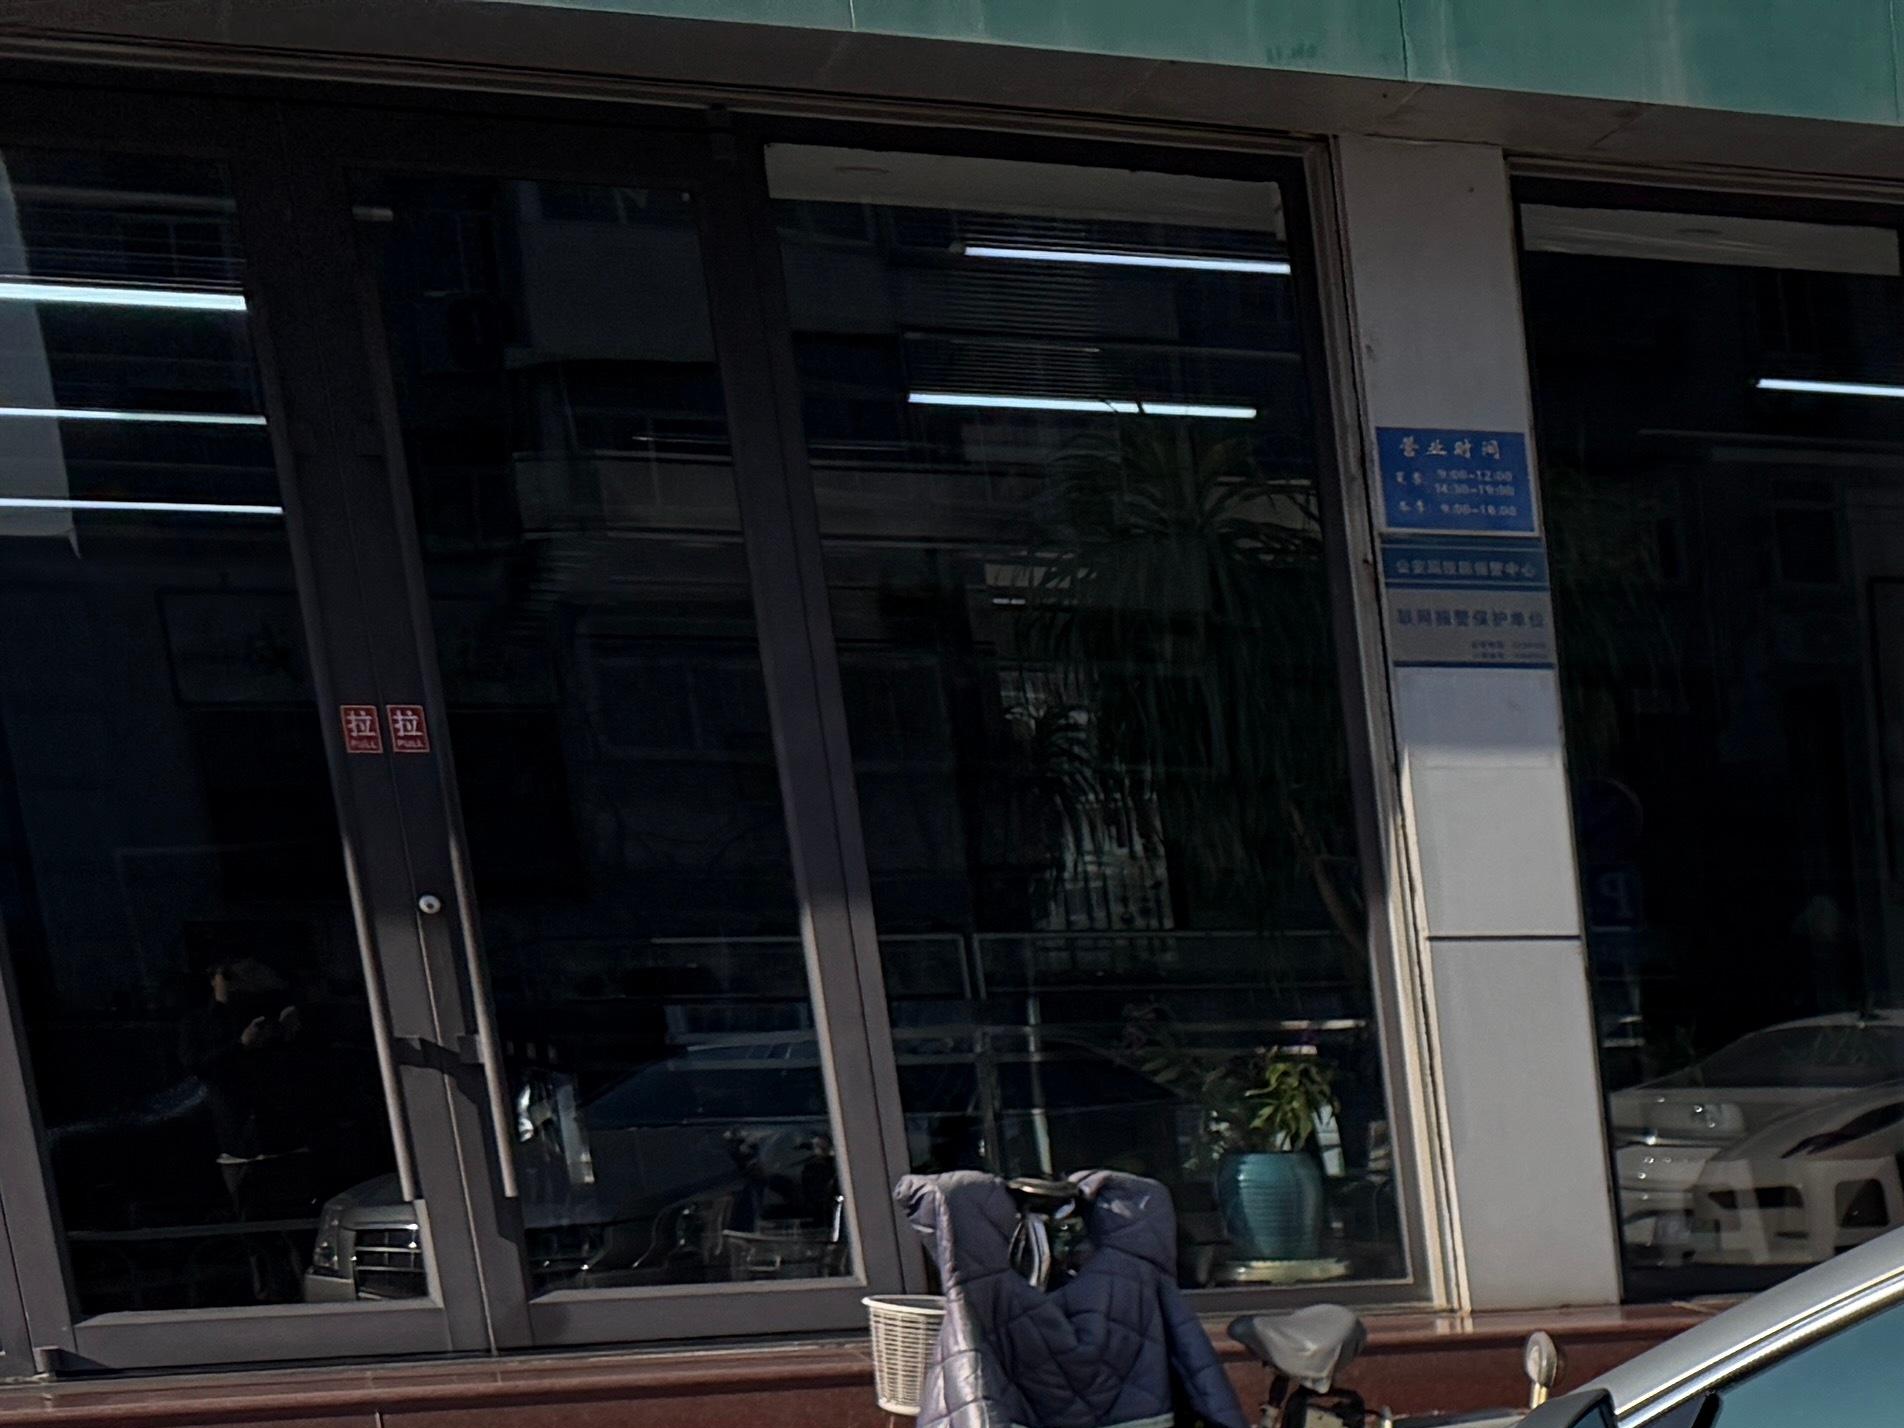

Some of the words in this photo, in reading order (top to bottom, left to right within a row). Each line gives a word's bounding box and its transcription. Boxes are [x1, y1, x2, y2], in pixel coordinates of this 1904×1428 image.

[1400, 436, 1501, 460] 营业时间
[346, 710, 377, 736] 拉
[392, 710, 423, 736] 拉
